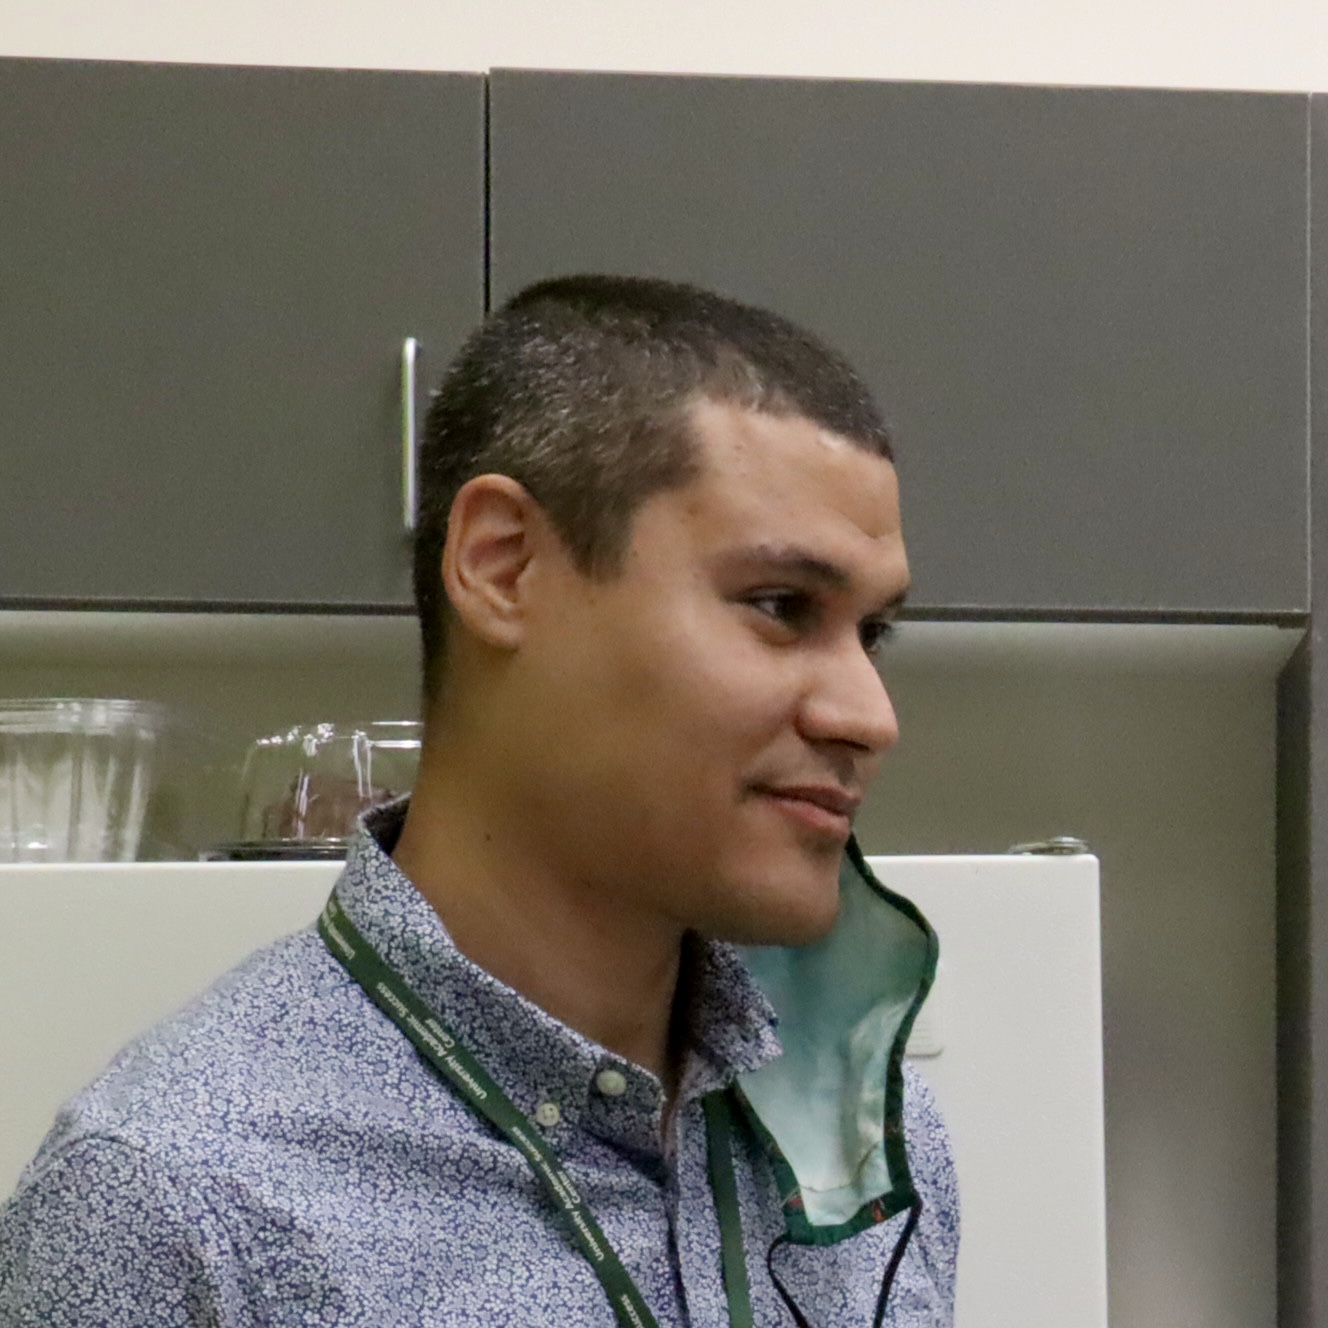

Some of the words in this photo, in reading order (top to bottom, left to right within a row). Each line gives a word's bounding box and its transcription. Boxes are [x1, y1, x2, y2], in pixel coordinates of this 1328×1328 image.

[375, 981, 410, 1019] Success
[405, 1012, 449, 1059] Academic
[424, 1018, 456, 1049] Center
[443, 1055, 488, 1101] University
[511, 1125, 544, 1162] Success
[541, 1162, 575, 1209] Academic
[556, 1170, 582, 1204] Center
[570, 1210, 605, 1262] University
